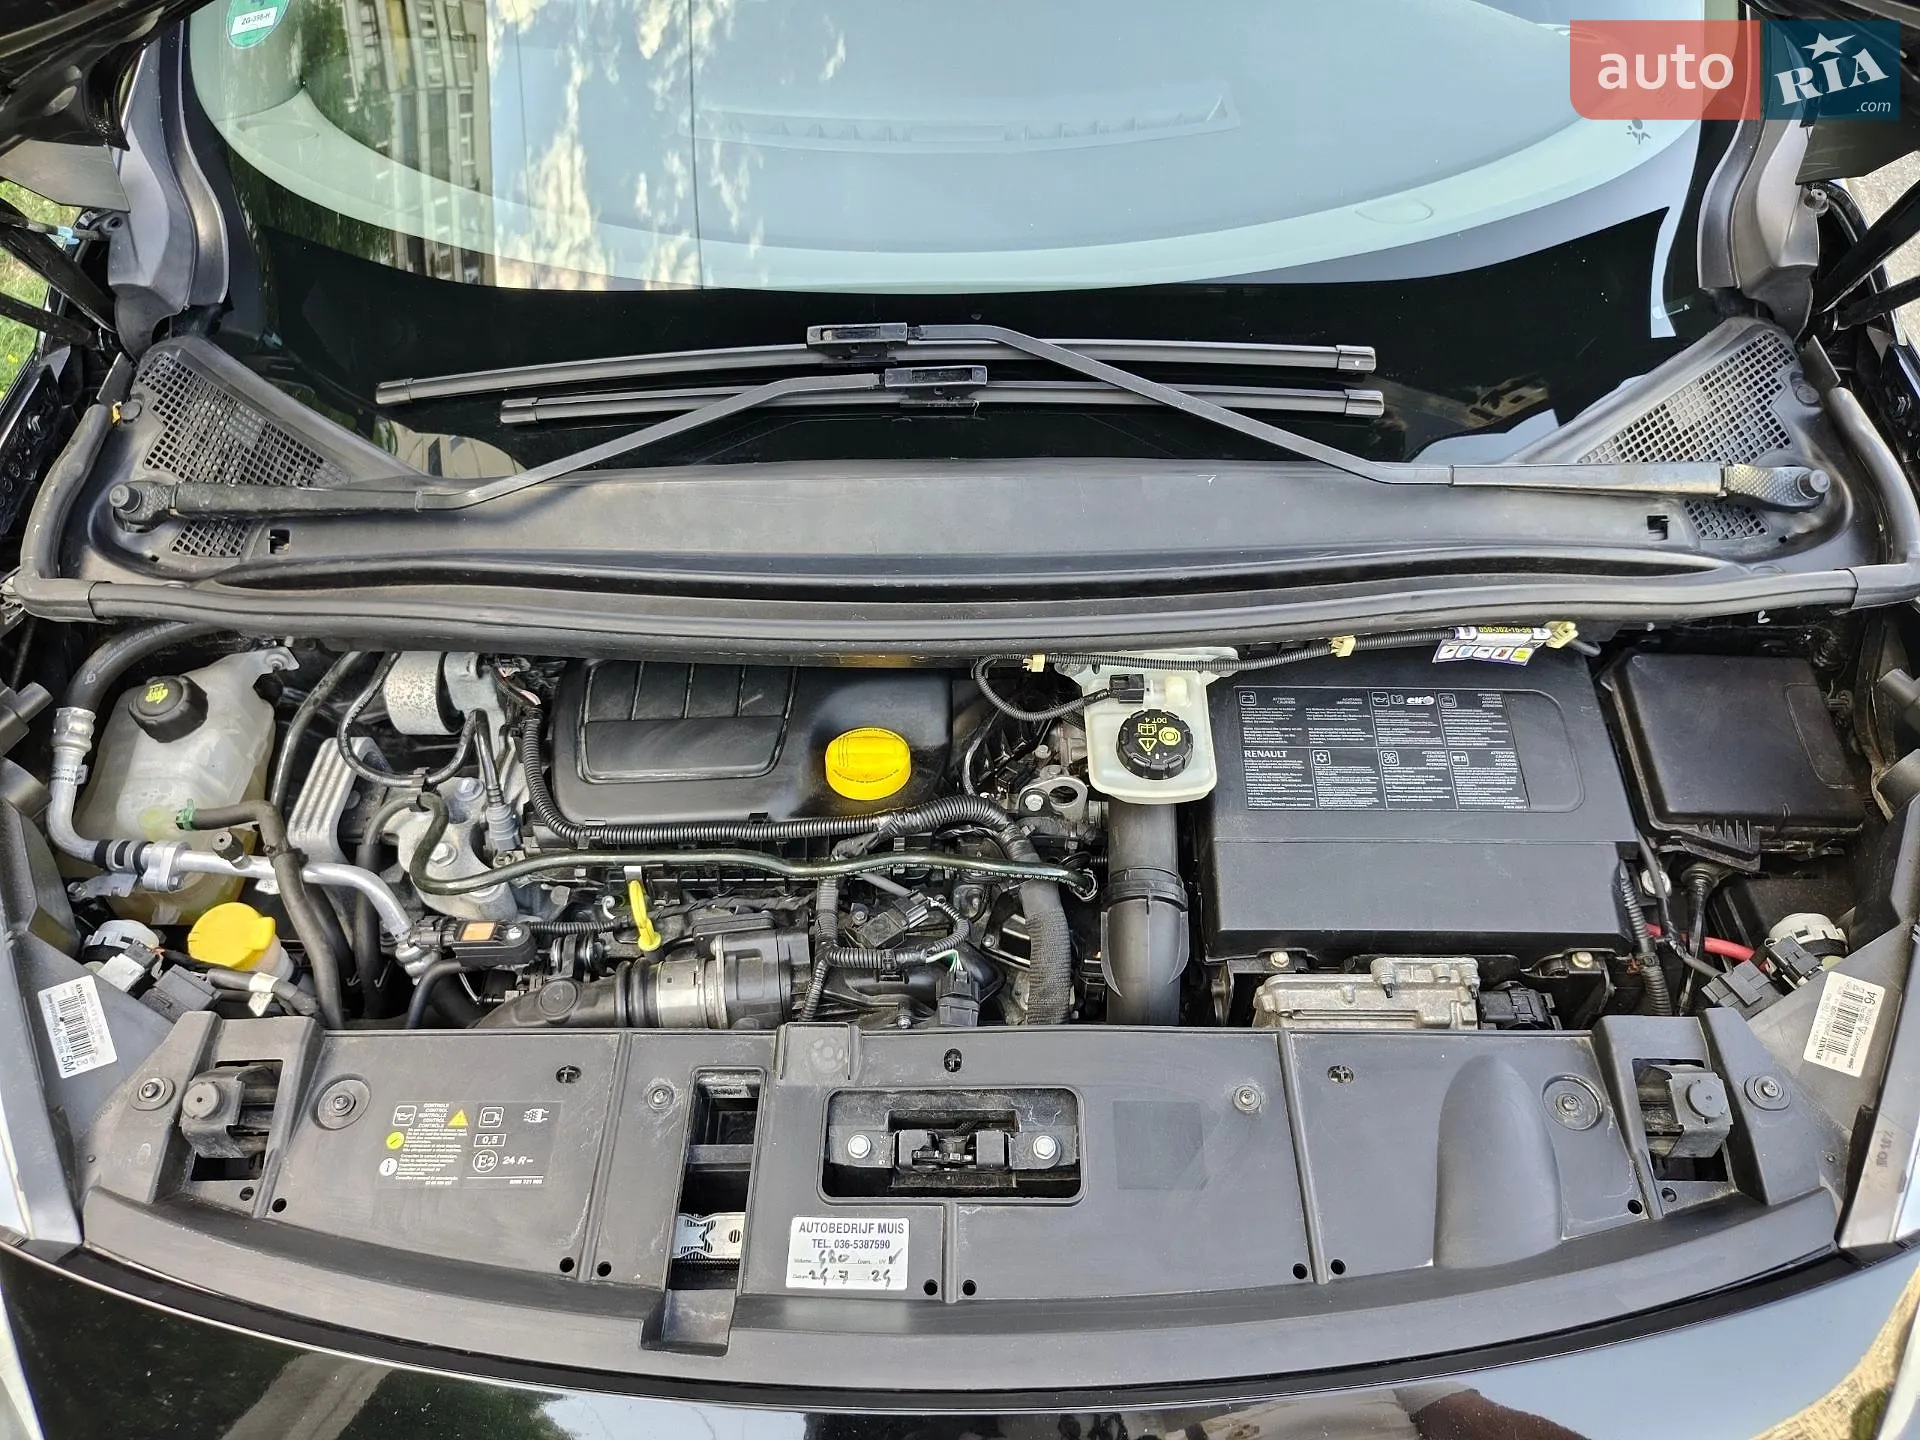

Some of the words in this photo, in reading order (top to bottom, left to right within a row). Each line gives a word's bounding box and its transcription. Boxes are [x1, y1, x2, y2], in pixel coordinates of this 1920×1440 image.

[1244, 750, 1287, 758] RENAULT
[1864, 991, 1877, 1005] 94
[61, 1055, 77, 1073] 5M
[482, 1135, 499, 1145] 0,5
[476, 1154, 495, 1168] E2
[502, 1156, 516, 1165] 24
[799, 1222, 875, 1234] AUTOBEDRIJF
[878, 1223, 905, 1234] MUIS
[812, 1239, 831, 1249] TEL.
[834, 1240, 891, 1249] 036-5387590
